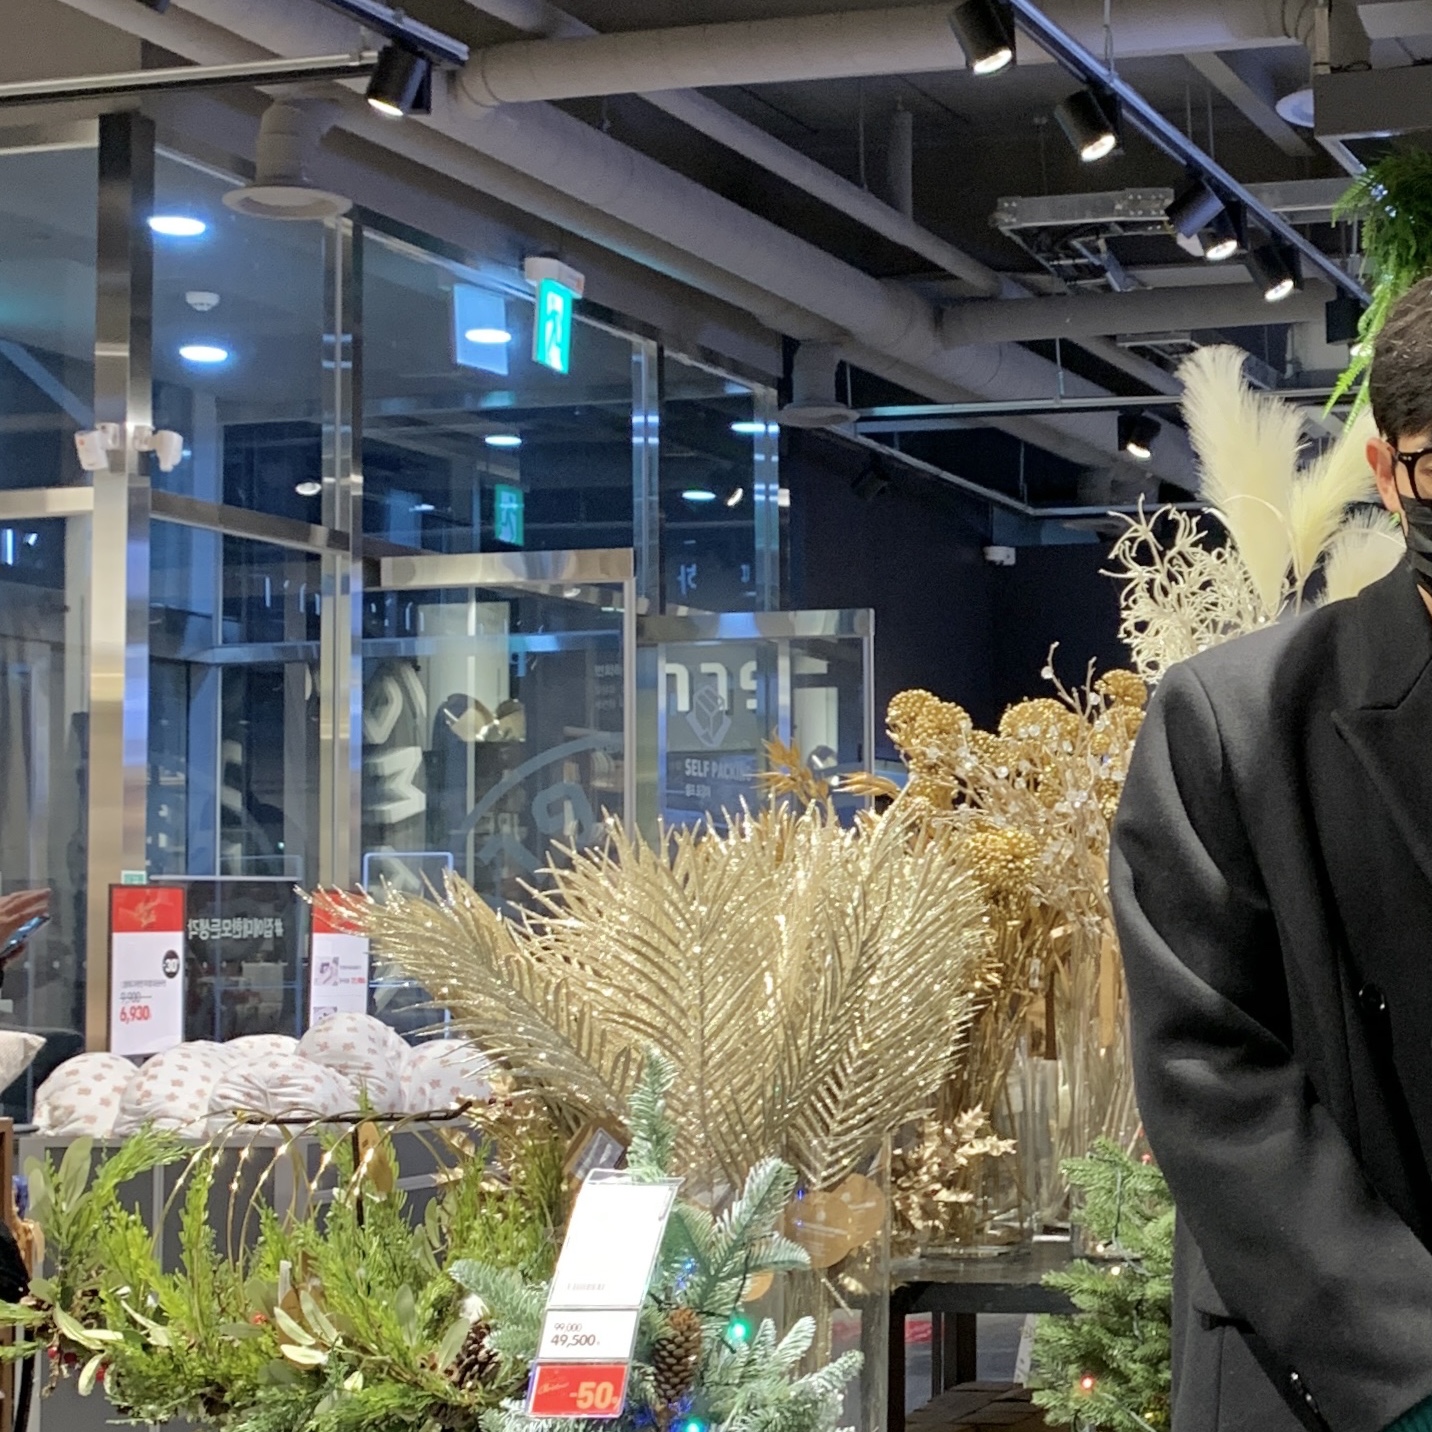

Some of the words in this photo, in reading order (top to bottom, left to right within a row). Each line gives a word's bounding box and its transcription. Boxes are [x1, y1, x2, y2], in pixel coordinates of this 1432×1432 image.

[685, 758, 710, 778] SELF
[119, 1005, 150, 1024] 6,930
[554, 1322, 583, 1333] 99,000
[550, 1334, 596, 1348] 49,500
